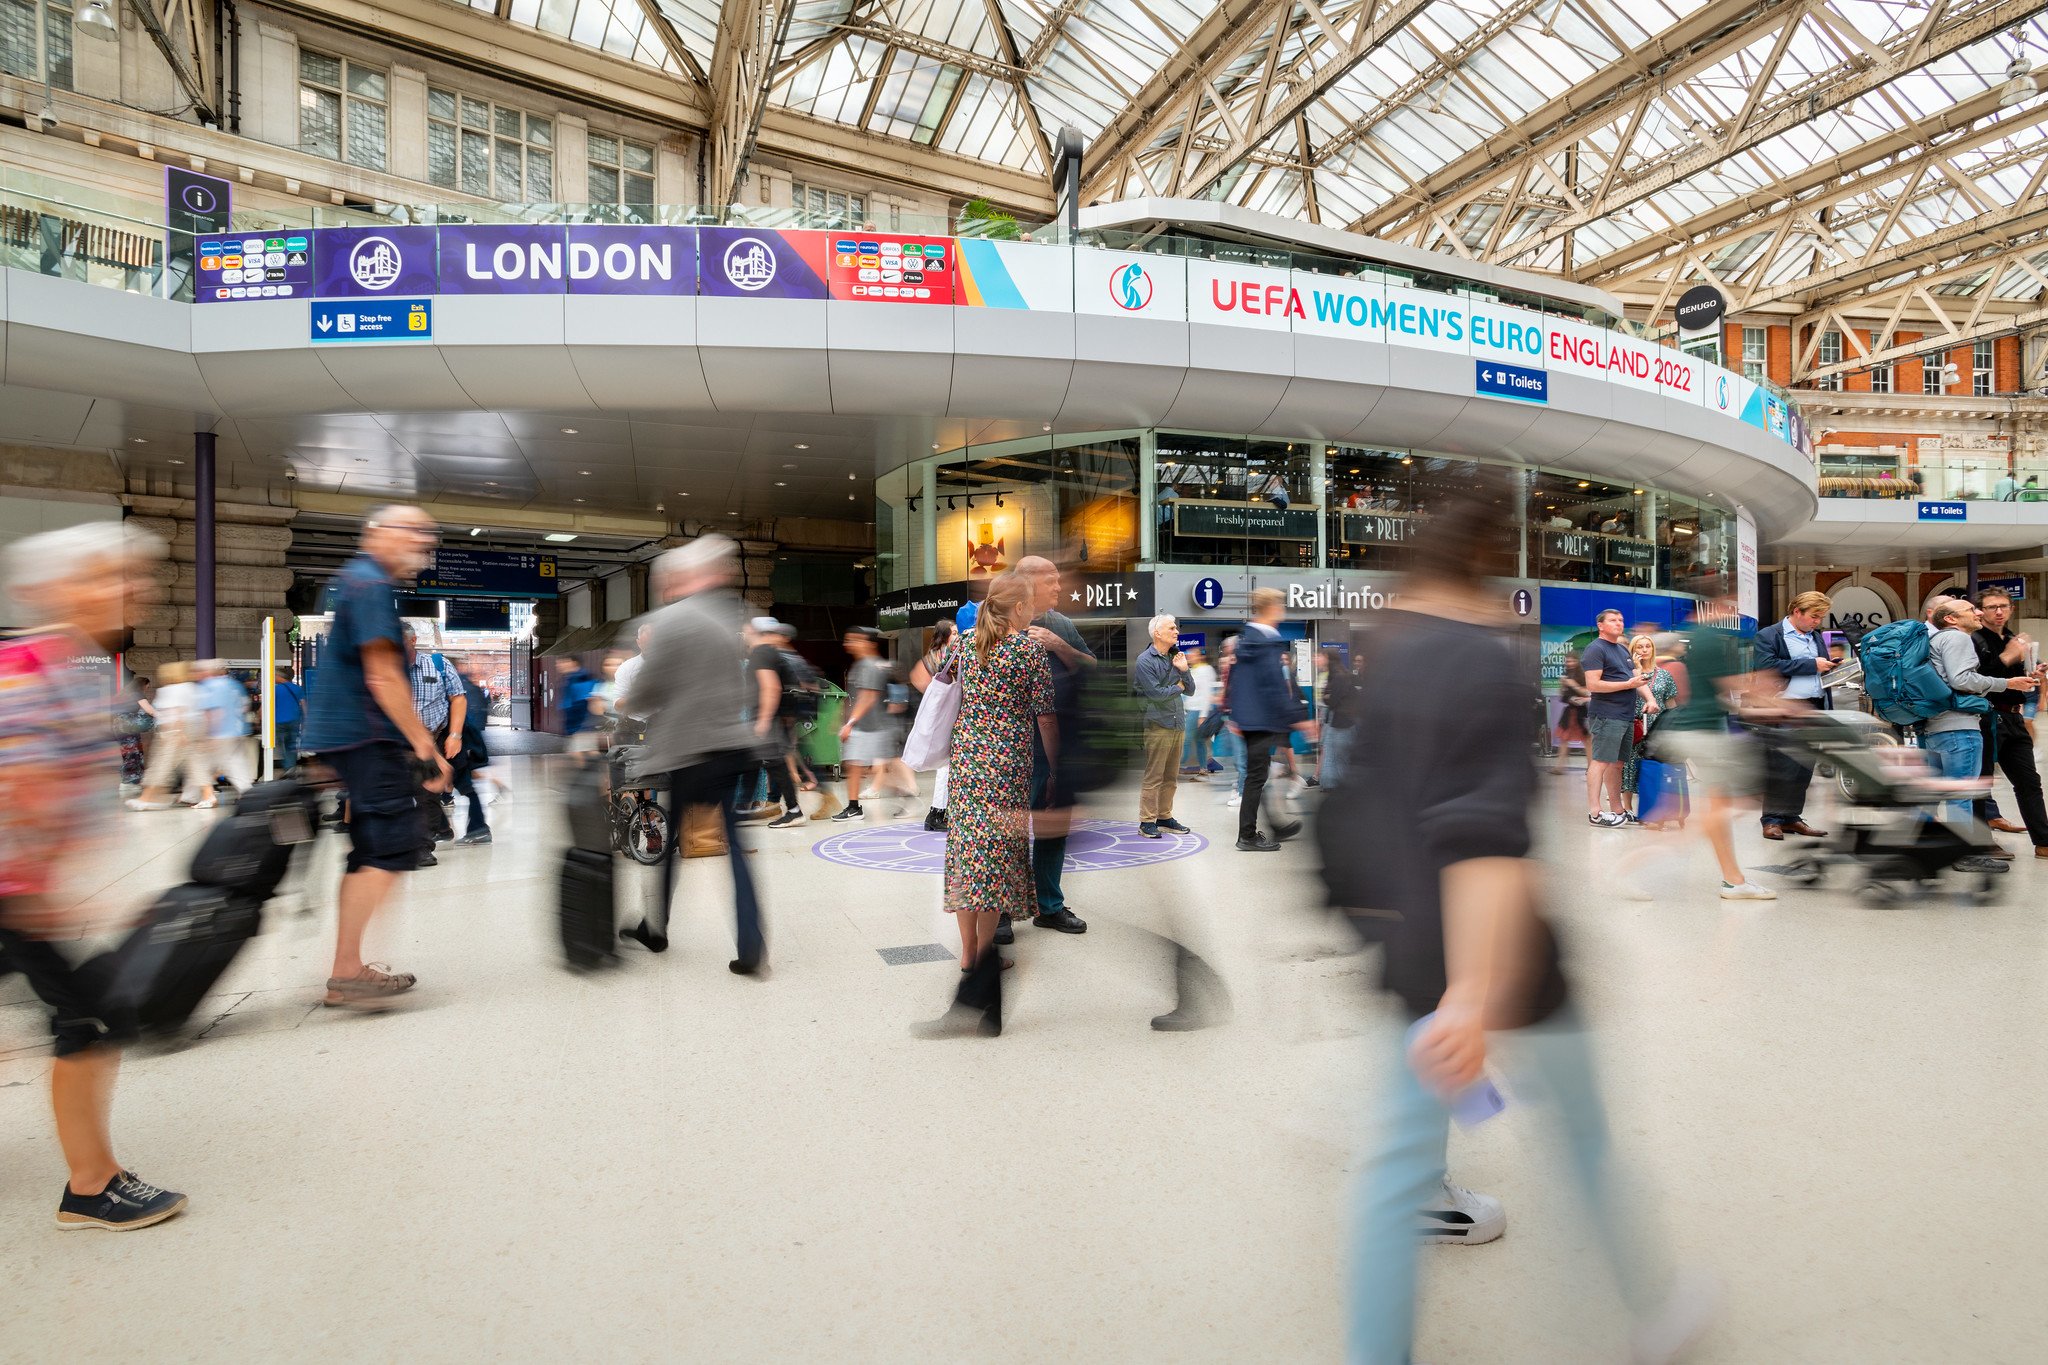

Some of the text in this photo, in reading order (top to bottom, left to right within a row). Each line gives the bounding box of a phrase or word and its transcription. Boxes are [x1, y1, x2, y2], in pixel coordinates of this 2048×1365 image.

[466, 242, 672, 280] LONDON
[1680, 300, 1716, 315] BENUGO
[414, 315, 422, 328] 3
[1212, 279, 1690, 392] UEFA WOMEN'S EURO ENGLAND 2022
[1509, 374, 1542, 390] Toilets
[1216, 514, 1284, 528] Freshly prepared
[1377, 518, 1405, 541] PRET
[1564, 535, 1582, 556] PRET
[543, 564, 551, 575] 3
[1086, 584, 1122, 606] PRET
[1289, 583, 1332, 608] Rail
[911, 600, 936, 611] Waterloo
[937, 598, 958, 608] Station
[1695, 600, 1741, 630] WHSmith
[67, 655, 111, 664] NatWest
[1541, 655, 1566, 665] ECYCLED
